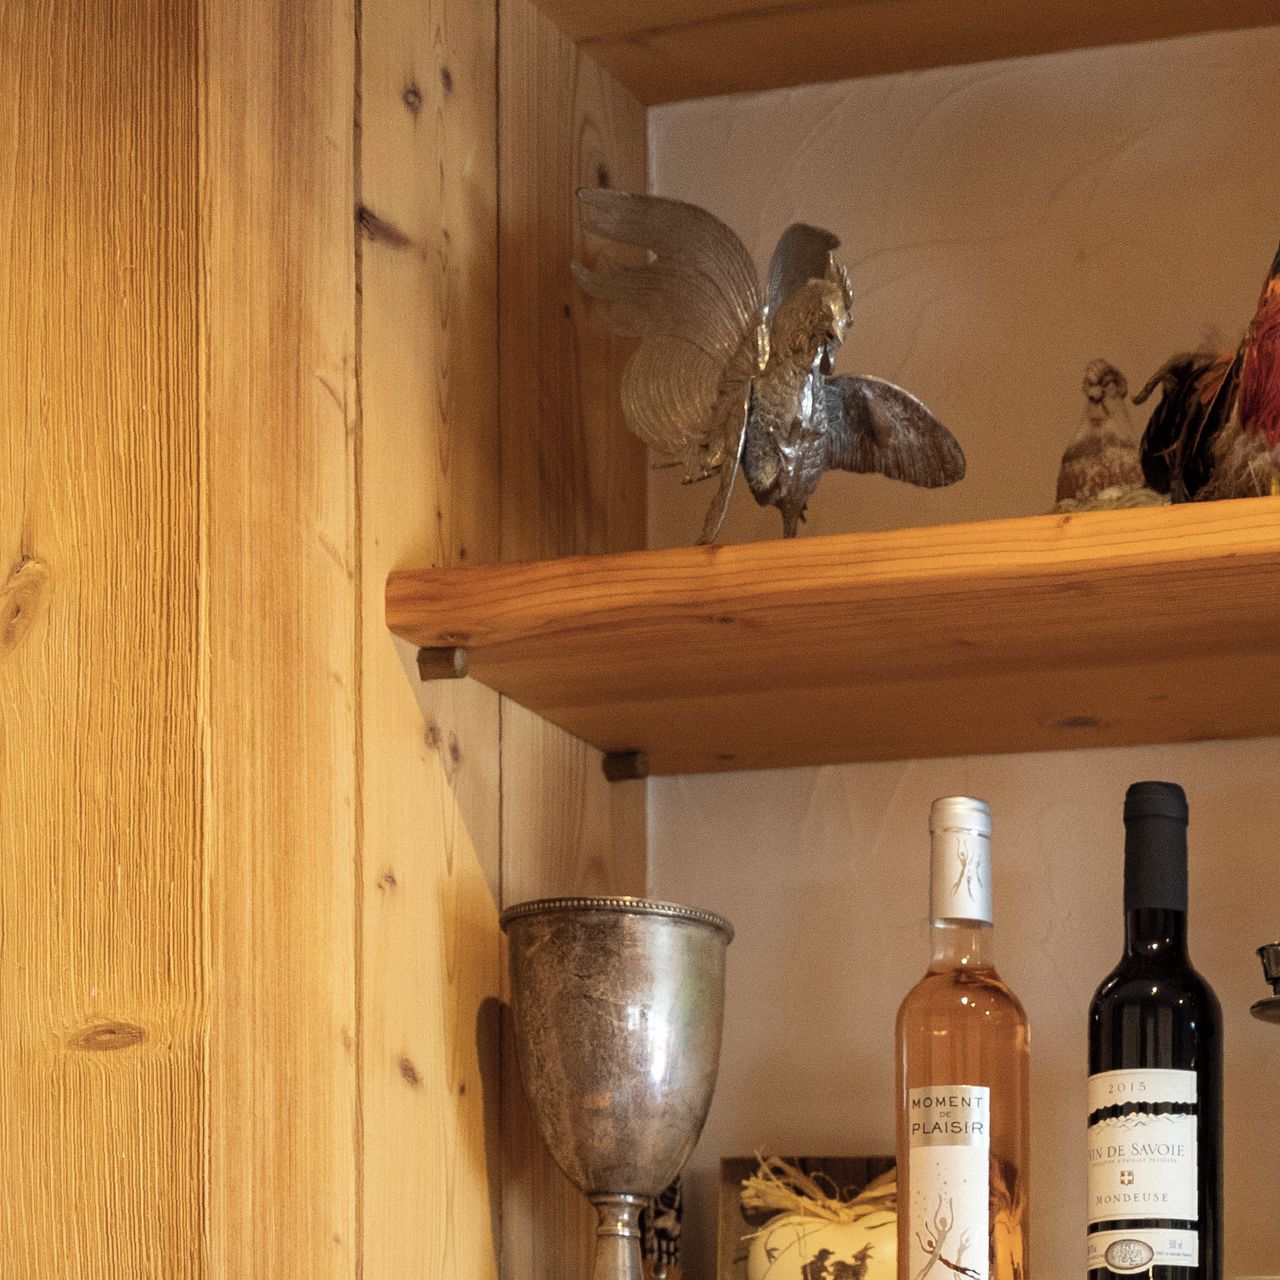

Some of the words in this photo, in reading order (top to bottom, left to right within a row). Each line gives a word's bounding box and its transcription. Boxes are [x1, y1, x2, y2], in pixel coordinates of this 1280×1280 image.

[1108, 1082, 1146, 1094] 2015
[912, 1096, 984, 1110] MOMENT
[912, 1121, 984, 1135] PLAISIR
[1108, 1146, 1125, 1158] DE
[1131, 1142, 1185, 1156] SAVOIE
[1096, 1193, 1168, 1205] MONDEUSE
